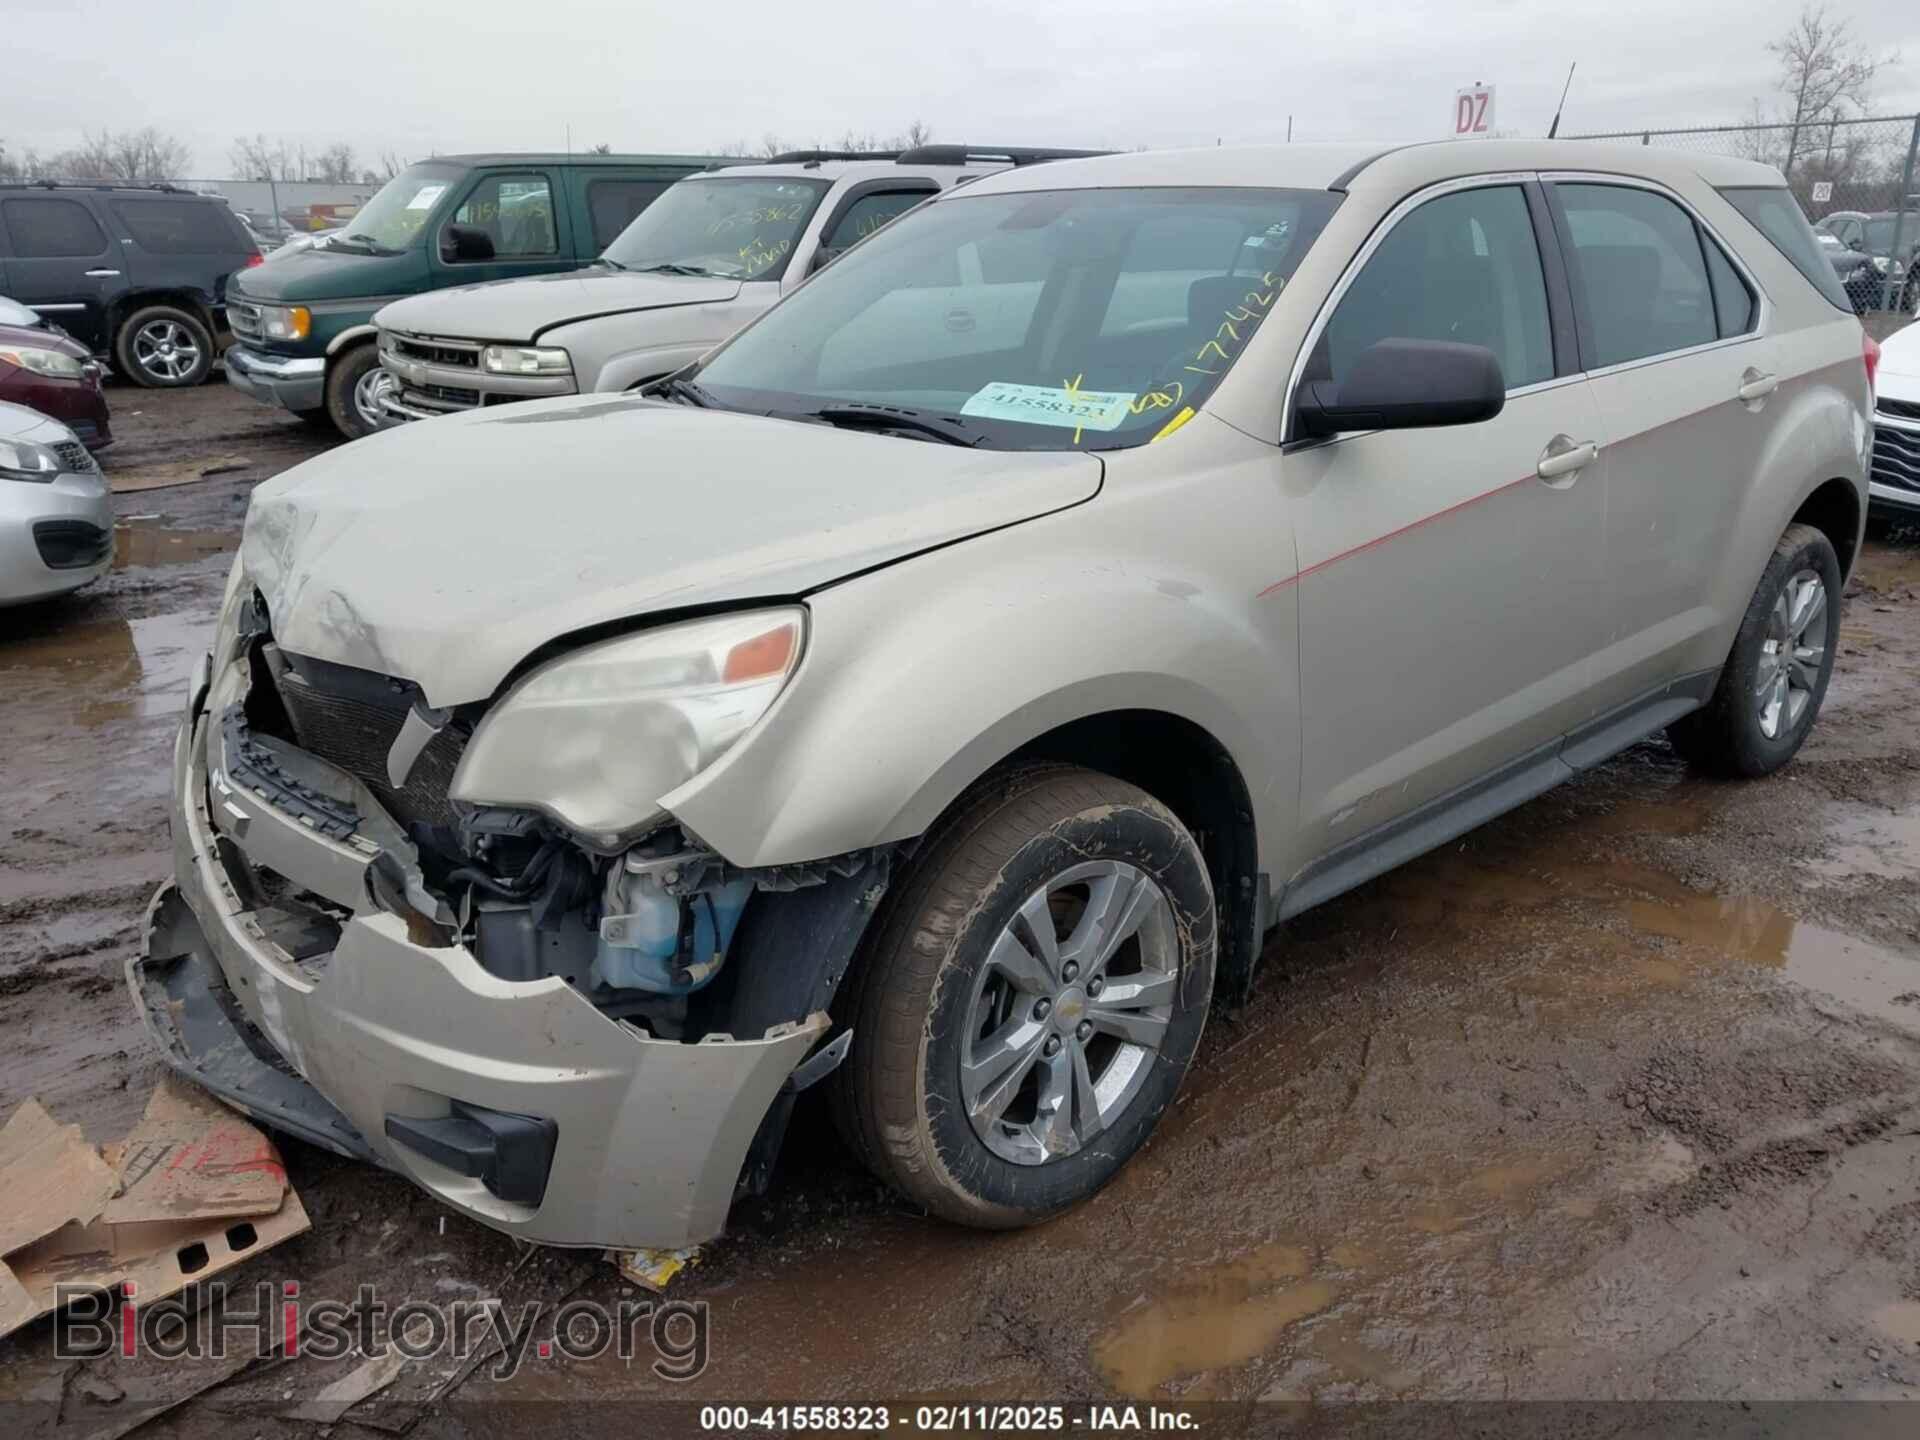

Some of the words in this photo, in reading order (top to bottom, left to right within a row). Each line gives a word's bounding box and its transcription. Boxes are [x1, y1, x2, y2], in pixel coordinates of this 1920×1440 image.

[1456, 93, 1488, 133] DZ
[1183, 271, 1285, 375] 177425
[990, 393, 1106, 418] 41558323
